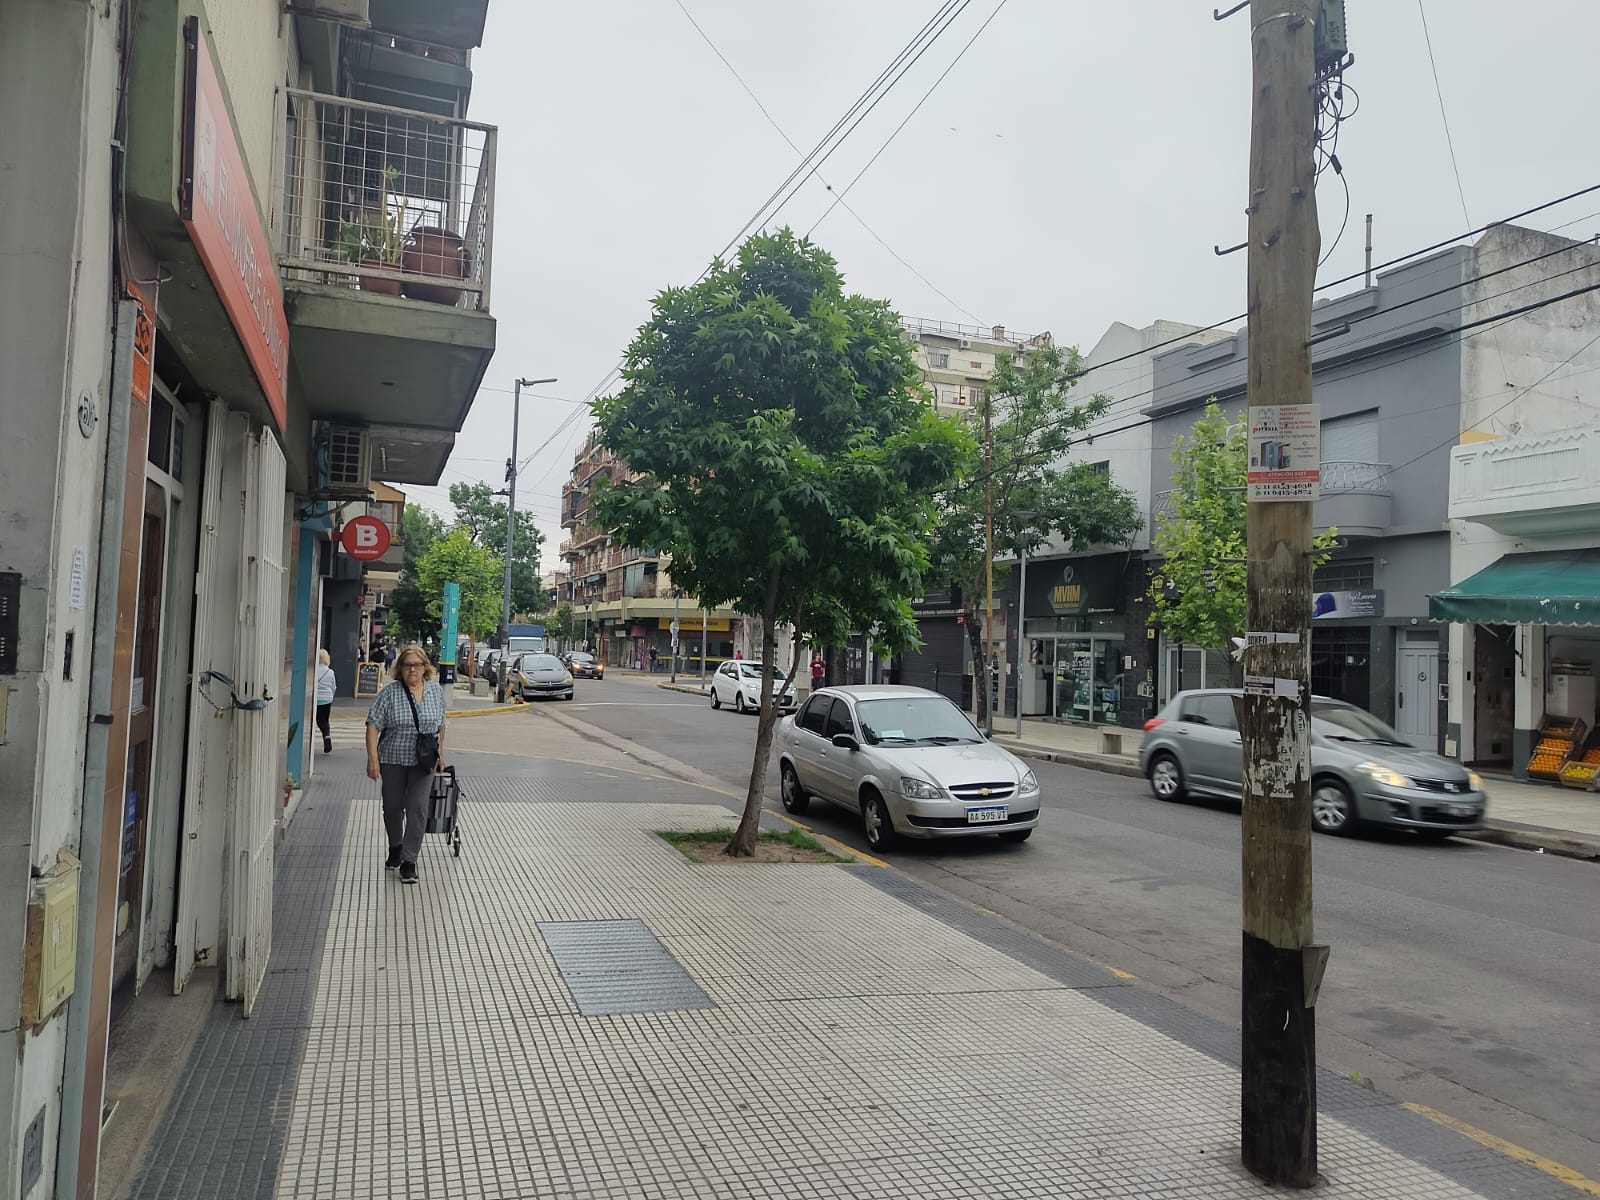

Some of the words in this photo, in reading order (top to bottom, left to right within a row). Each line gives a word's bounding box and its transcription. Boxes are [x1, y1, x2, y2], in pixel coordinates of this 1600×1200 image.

[218, 158, 230, 241] EL
[356, 523, 378, 546] B
[981, 811, 995, 820] 595
